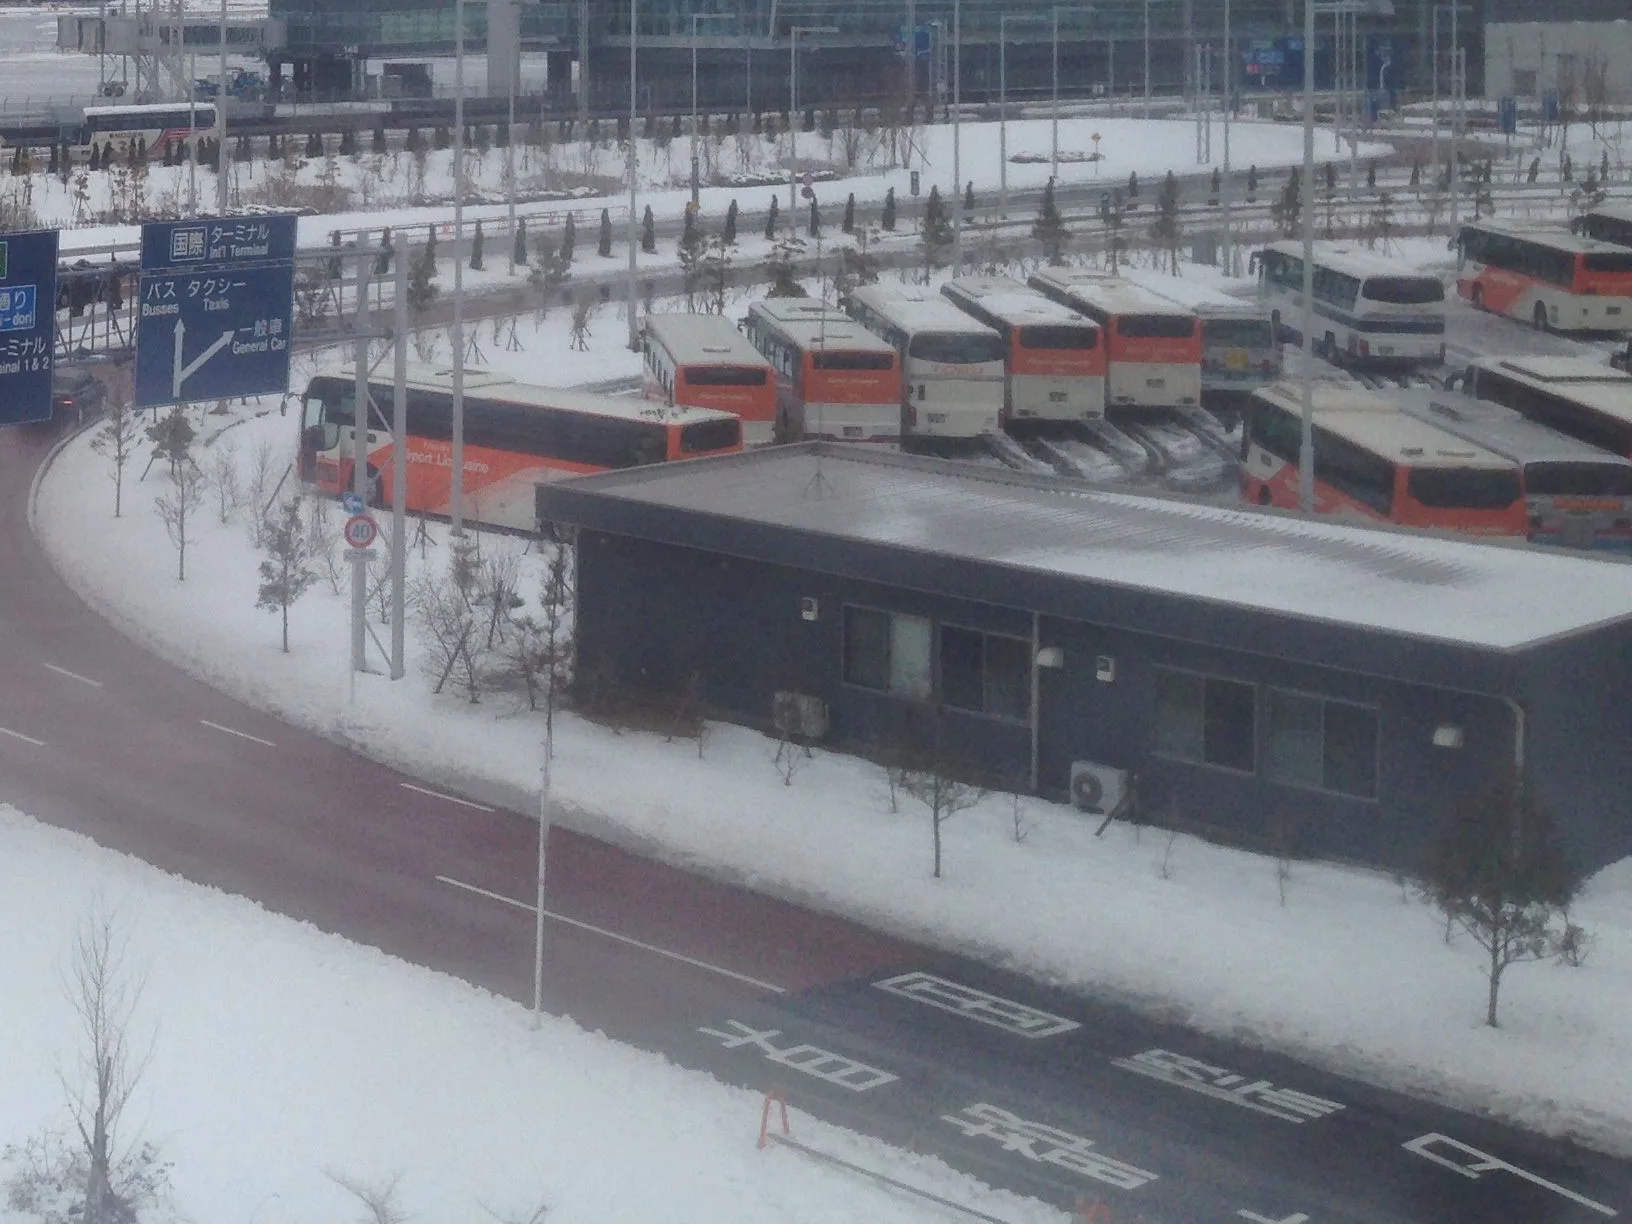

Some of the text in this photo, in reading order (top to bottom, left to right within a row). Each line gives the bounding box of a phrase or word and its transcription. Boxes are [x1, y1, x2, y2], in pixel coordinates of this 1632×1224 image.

[211, 224, 270, 243] ターミナル
[173, 232, 204, 256] 国際
[230, 243, 268, 257] Terminal
[146, 278, 247, 299] バス タクシー
[203, 298, 230, 311] Taxis
[239, 318, 283, 337] 一般車
[232, 337, 286, 355] General Car
[24, 359, 30, 372] 1
[31, 358, 40, 371] &
[42, 356, 50, 370] 2
